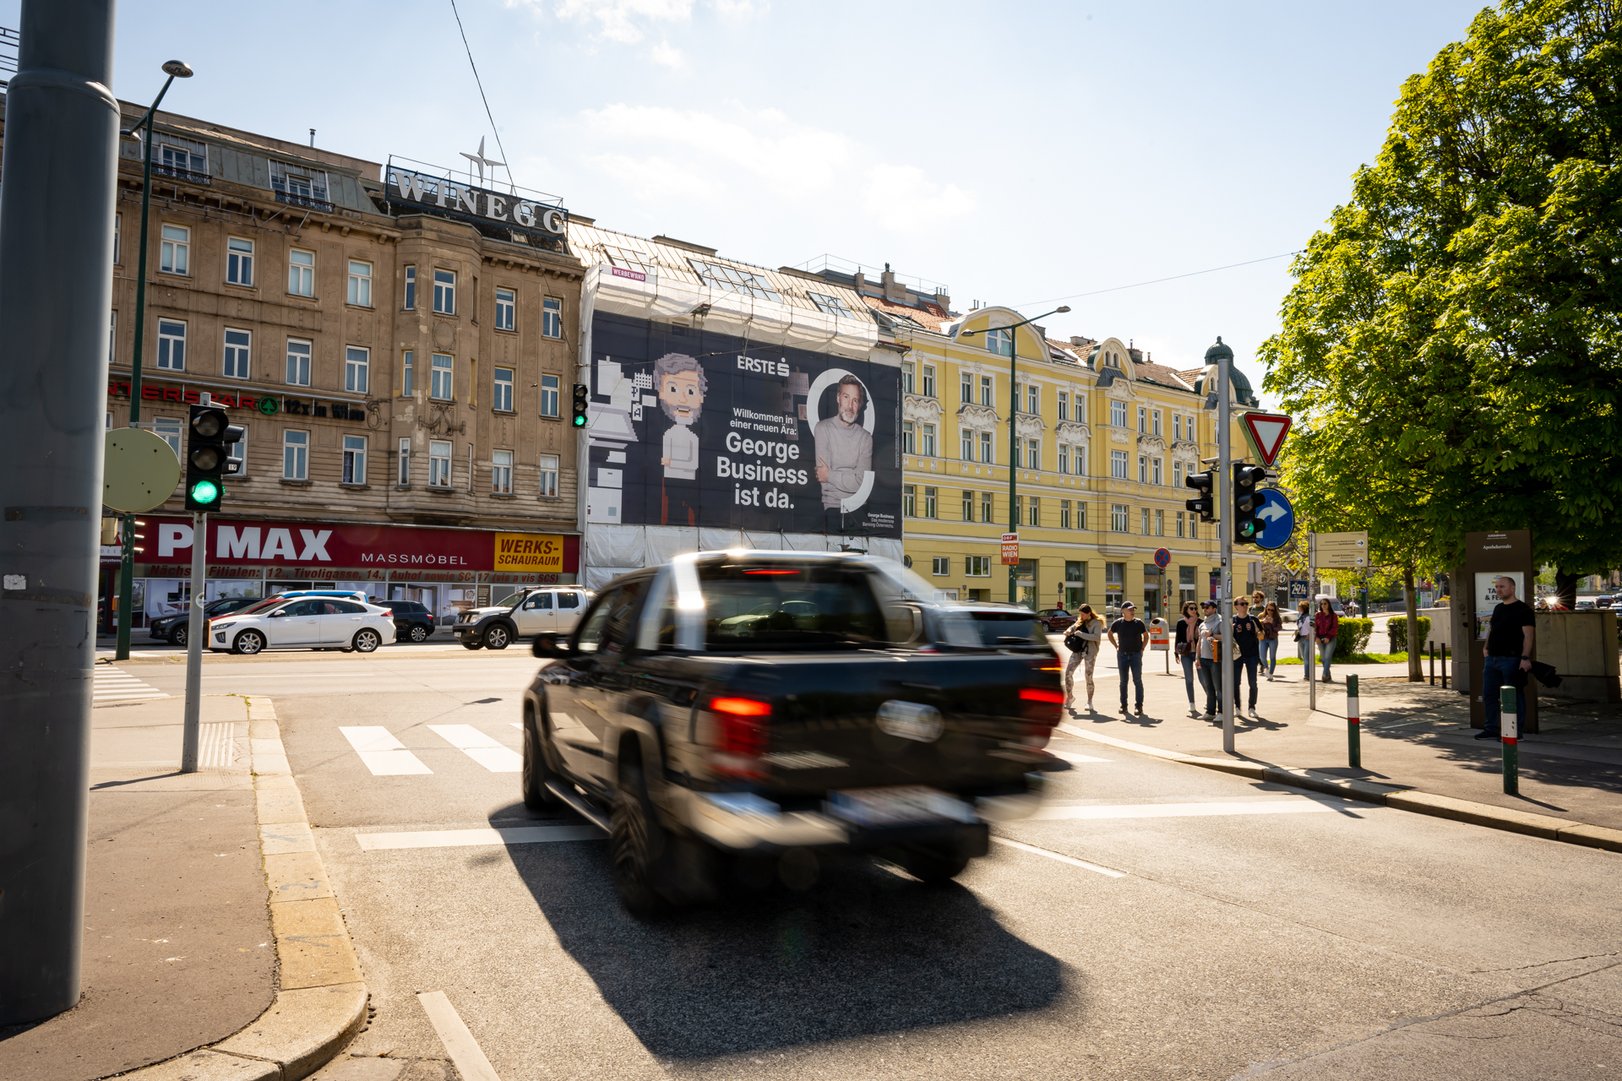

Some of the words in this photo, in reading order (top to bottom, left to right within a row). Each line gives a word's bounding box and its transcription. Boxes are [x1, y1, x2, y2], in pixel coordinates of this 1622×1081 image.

[393, 171, 565, 235] WINEGG
[737, 355, 775, 375] ERSTE
[733, 407, 784, 423] Willkommen
[785, 415, 793, 425] in
[730, 418, 751, 430] einer
[753, 422, 778, 433] neuen
[781, 424, 797, 436] Ära:
[726, 431, 800, 463] George
[717, 455, 808, 485] Business
[734, 483, 759, 507] ist
[765, 487, 795, 509] da.
[158, 523, 333, 562] PMAX
[500, 538, 559, 555] WERKS-
[361, 552, 468, 566] MASSMÖBEL
[498, 554, 560, 566] SCHAURAUM
[150, 565, 192, 577] Nächs
[208, 566, 261, 578] Filialen:
